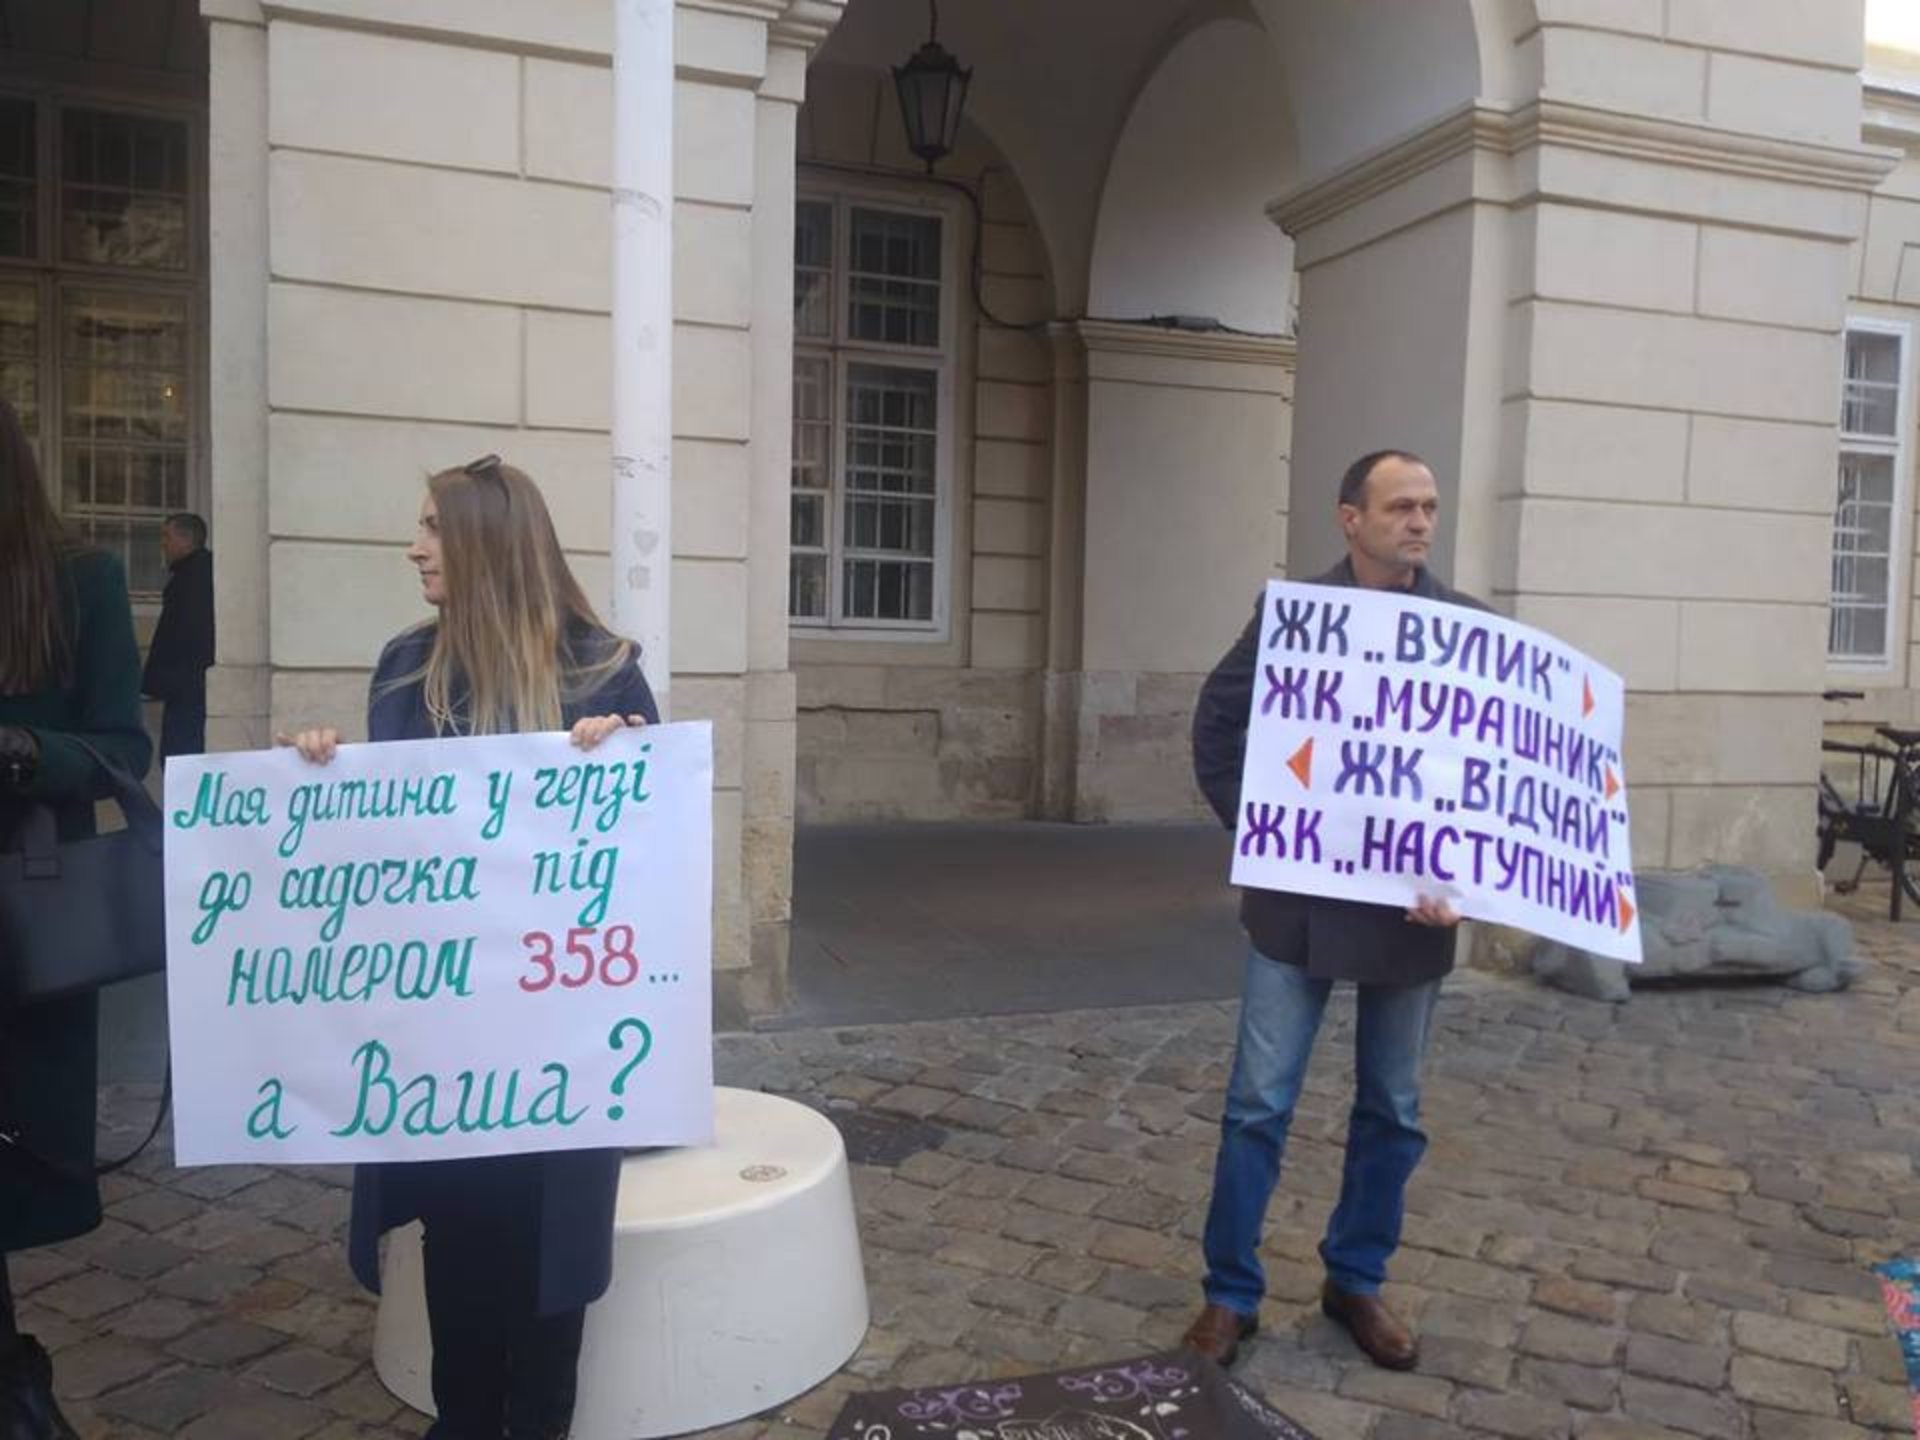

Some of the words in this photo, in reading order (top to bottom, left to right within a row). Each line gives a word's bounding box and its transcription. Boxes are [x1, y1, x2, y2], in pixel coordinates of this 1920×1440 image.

[1267, 598, 1351, 657] ЖК
[1260, 664, 1345, 724] ЖК
[174, 772, 271, 829] Моя
[278, 772, 458, 859] дитина
[481, 769, 513, 840] у
[534, 743, 651, 833] черзі
[1334, 740, 1424, 803] ЖК
[1239, 802, 1323, 865] ЖК
[192, 870, 251, 945] до
[280, 855, 480, 941] садочка
[532, 838, 619, 927] під
[226, 936, 479, 1006] номером
